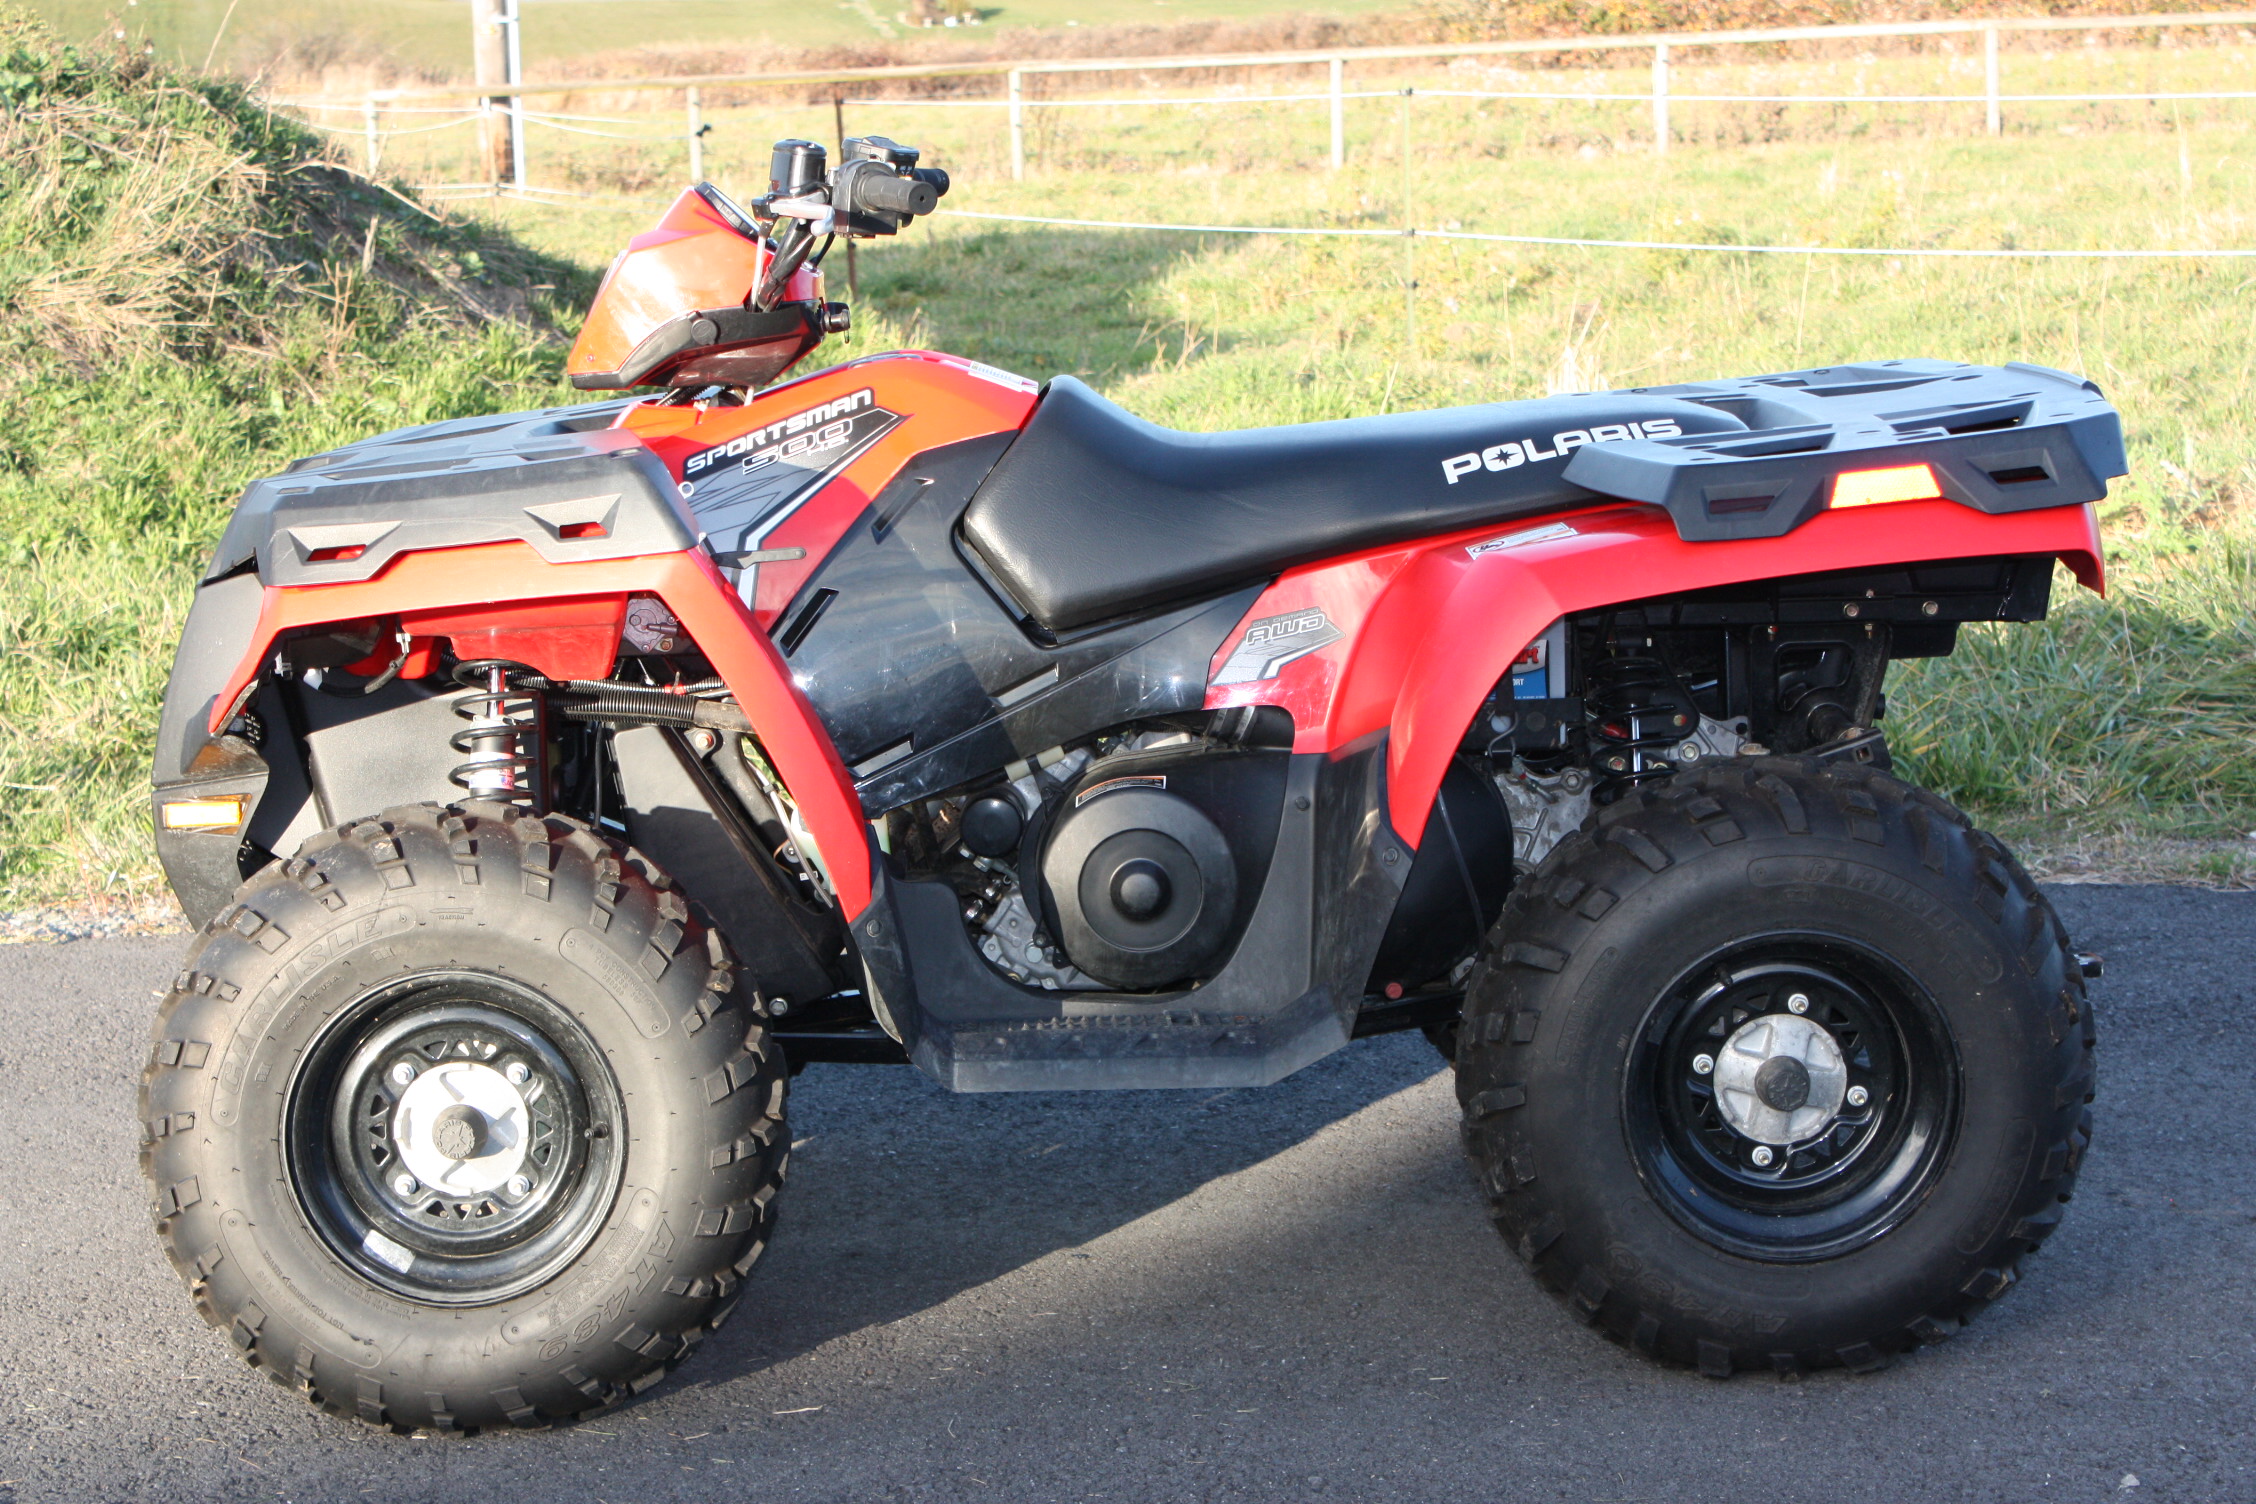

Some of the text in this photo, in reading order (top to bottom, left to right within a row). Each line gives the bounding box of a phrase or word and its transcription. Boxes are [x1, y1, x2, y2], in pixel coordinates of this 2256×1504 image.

[687, 389, 871, 474] SPORTSMAN
[742, 418, 853, 476] 500
[1442, 418, 1682, 484] POLARIS
[1245, 613, 1325, 645] AWD
[1273, 609, 1319, 623] DEMAND
[220, 916, 382, 1096] CARLISLE
[539, 1218, 676, 1362] AT489
